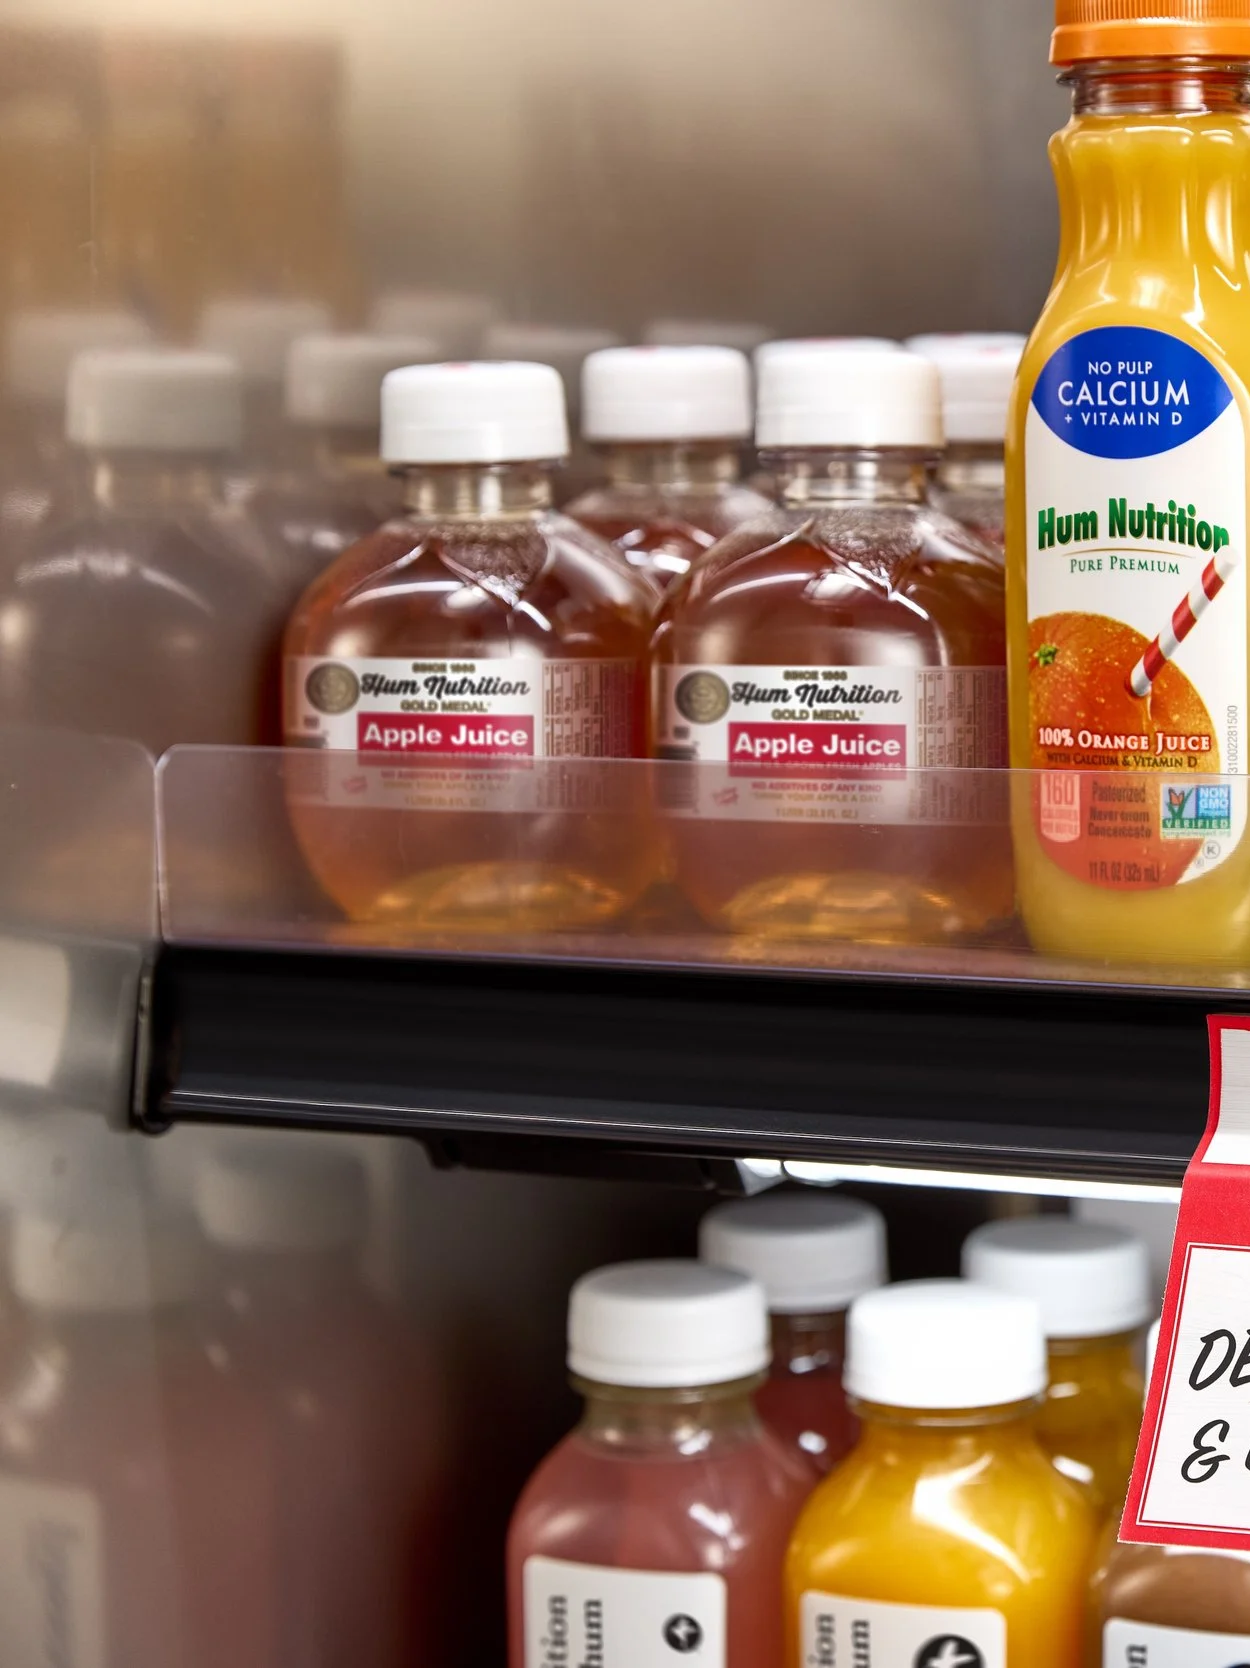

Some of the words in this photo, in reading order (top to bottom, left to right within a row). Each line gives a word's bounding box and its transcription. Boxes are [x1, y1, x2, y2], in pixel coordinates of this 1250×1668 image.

[1088, 362, 1112, 375] NO
[1118, 361, 1153, 374] PULP
[1058, 380, 1190, 406] CALCIUM
[1082, 412, 1160, 425] VITAMIN
[1171, 412, 1182, 425] D
[1038, 507, 1099, 550] Hum
[1109, 498, 1230, 554] Nutrition
[361, 673, 420, 698] Hum
[424, 676, 530, 699] Nutrition
[731, 682, 790, 704] Hum
[795, 683, 902, 708] Nutrition
[401, 701, 438, 713] GOLD
[771, 709, 809, 721] GOLD
[364, 722, 442, 748] Apple
[450, 725, 528, 746] Juice
[734, 732, 813, 758] Apple
[822, 734, 901, 756] Juice
[1039, 728, 1074, 747] 100%
[1078, 731, 1149, 750] ORANGE
[1156, 732, 1212, 755] JUICE
[1122, 757, 1131, 767] &
[1133, 756, 1183, 768] VITAMIN
[1187, 755, 1198, 768] D
[1165, 819, 1229, 830] VERIFIED
[1181, 1419, 1229, 1483] &
